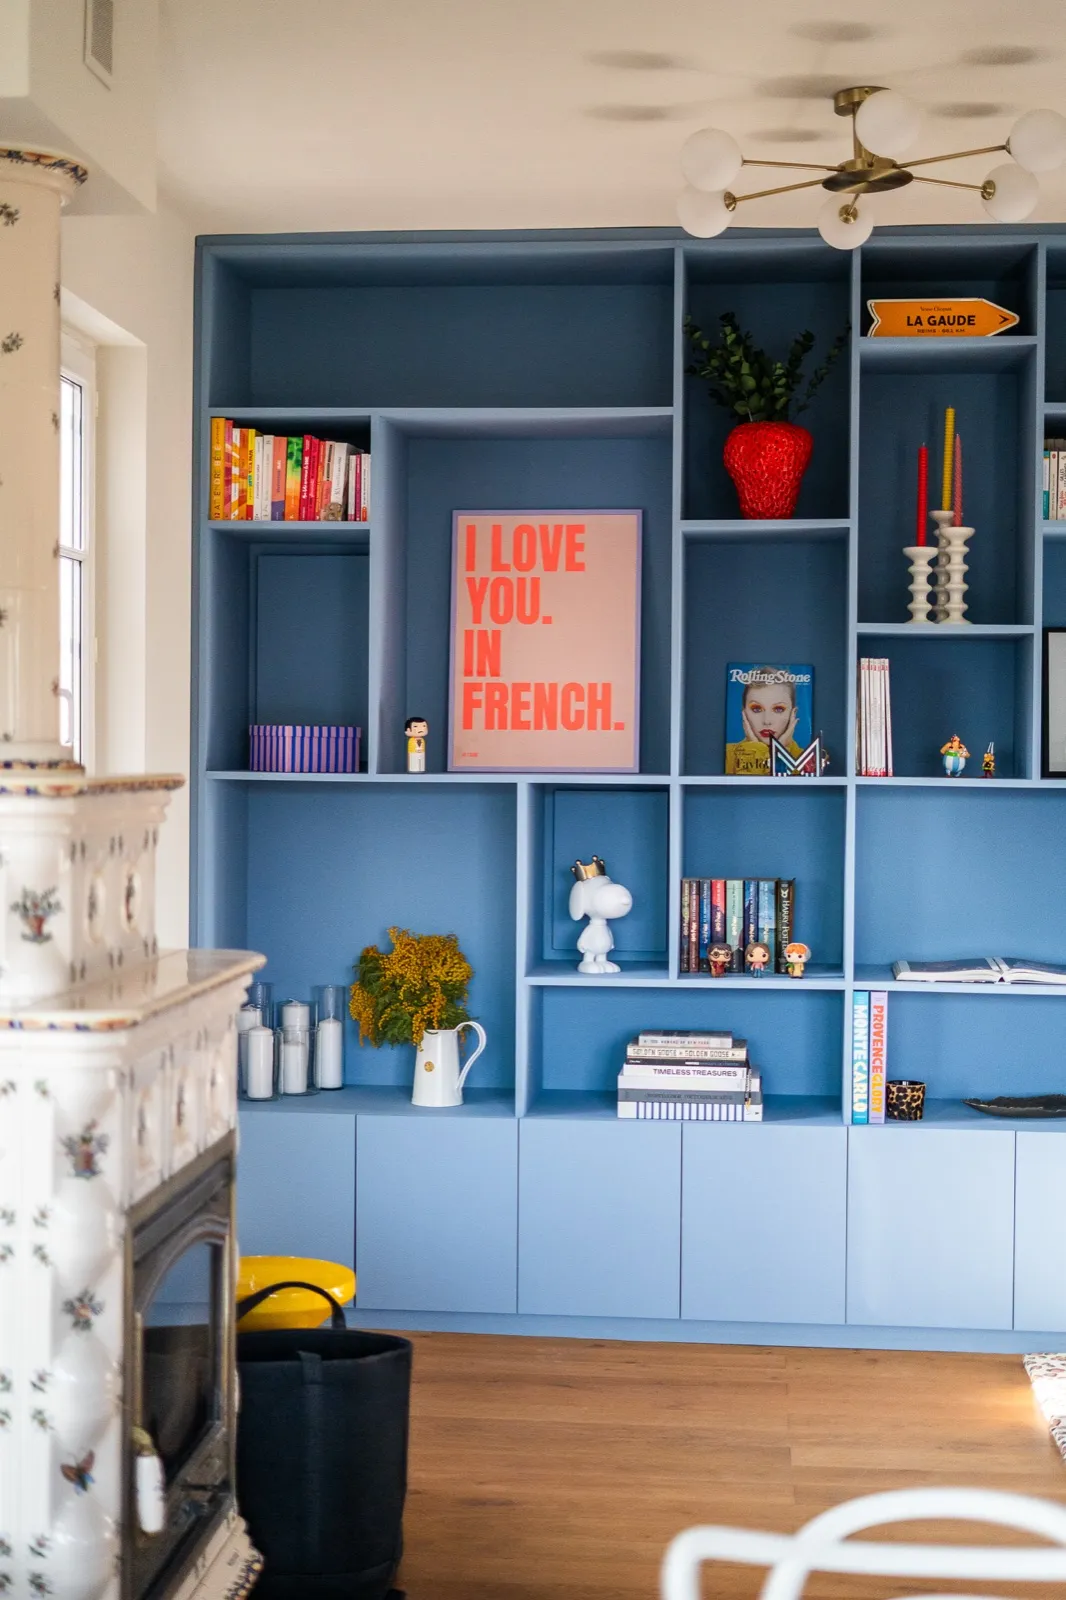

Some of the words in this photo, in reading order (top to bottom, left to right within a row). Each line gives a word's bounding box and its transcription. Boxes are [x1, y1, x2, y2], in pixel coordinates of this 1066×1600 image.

[907, 315, 923, 326] LA
[927, 315, 976, 326] GAUDE
[465, 524, 476, 572] I
[491, 524, 586, 572] LOVE
[465, 577, 553, 625] YOU.
[463, 629, 501, 677] IN
[462, 682, 625, 731] FRENCH.
[632, 1048, 656, 1056] GOLDEN
[685, 1049, 708, 1057] GOLDEN
[709, 1050, 730, 1058] GOOSE
[853, 1004, 868, 1061] MONTE
[871, 1005, 884, 1073] PROVENCE
[653, 1068, 691, 1076] TIMELESS
[692, 1069, 738, 1077] TREASURES
[853, 1061, 868, 1113] CARLO
[871, 1073, 883, 1113] GLORY
